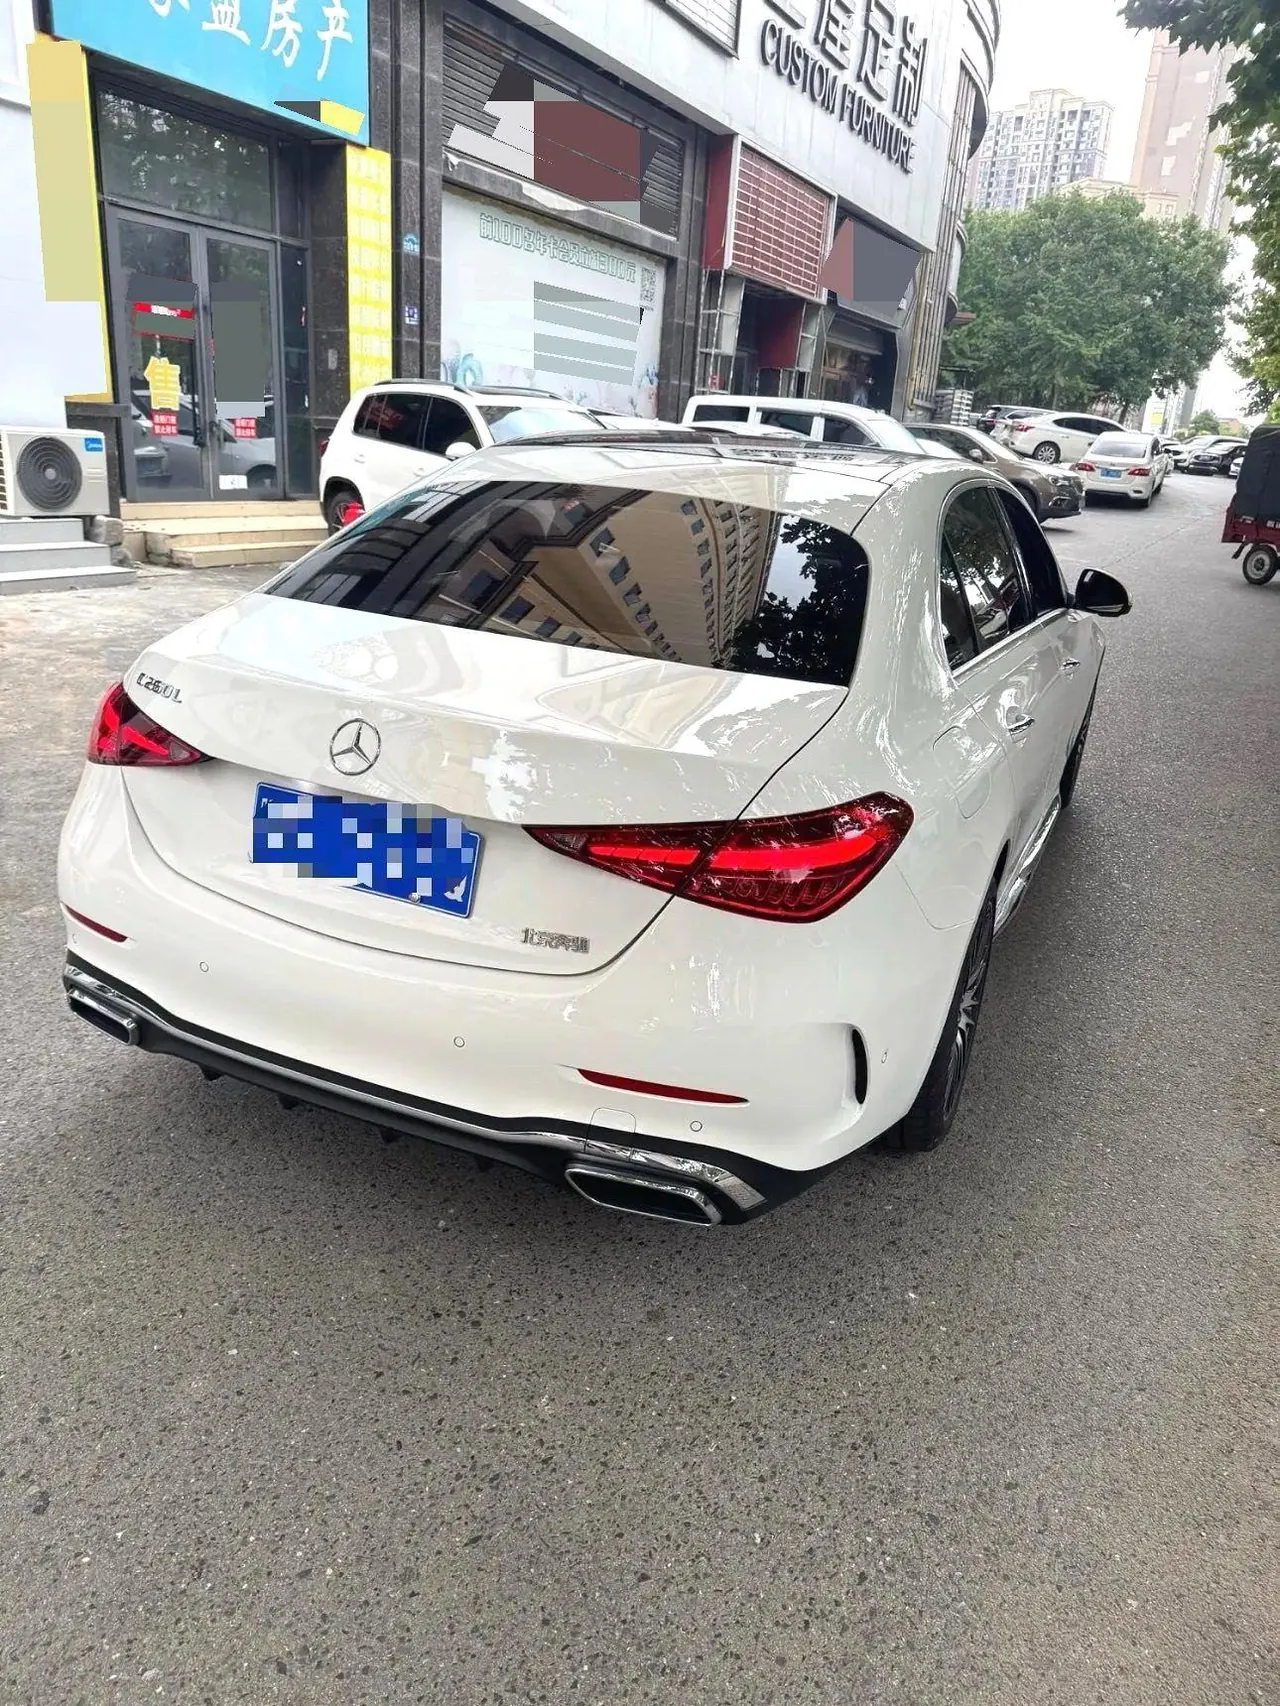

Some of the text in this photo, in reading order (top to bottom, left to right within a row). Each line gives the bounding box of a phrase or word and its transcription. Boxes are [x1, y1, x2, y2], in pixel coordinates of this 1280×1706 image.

[760, 19, 919, 174] CUSTOM FURNITURE
[143, 355, 181, 411] 售
[521, 927, 590, 954] 北京奔驰
